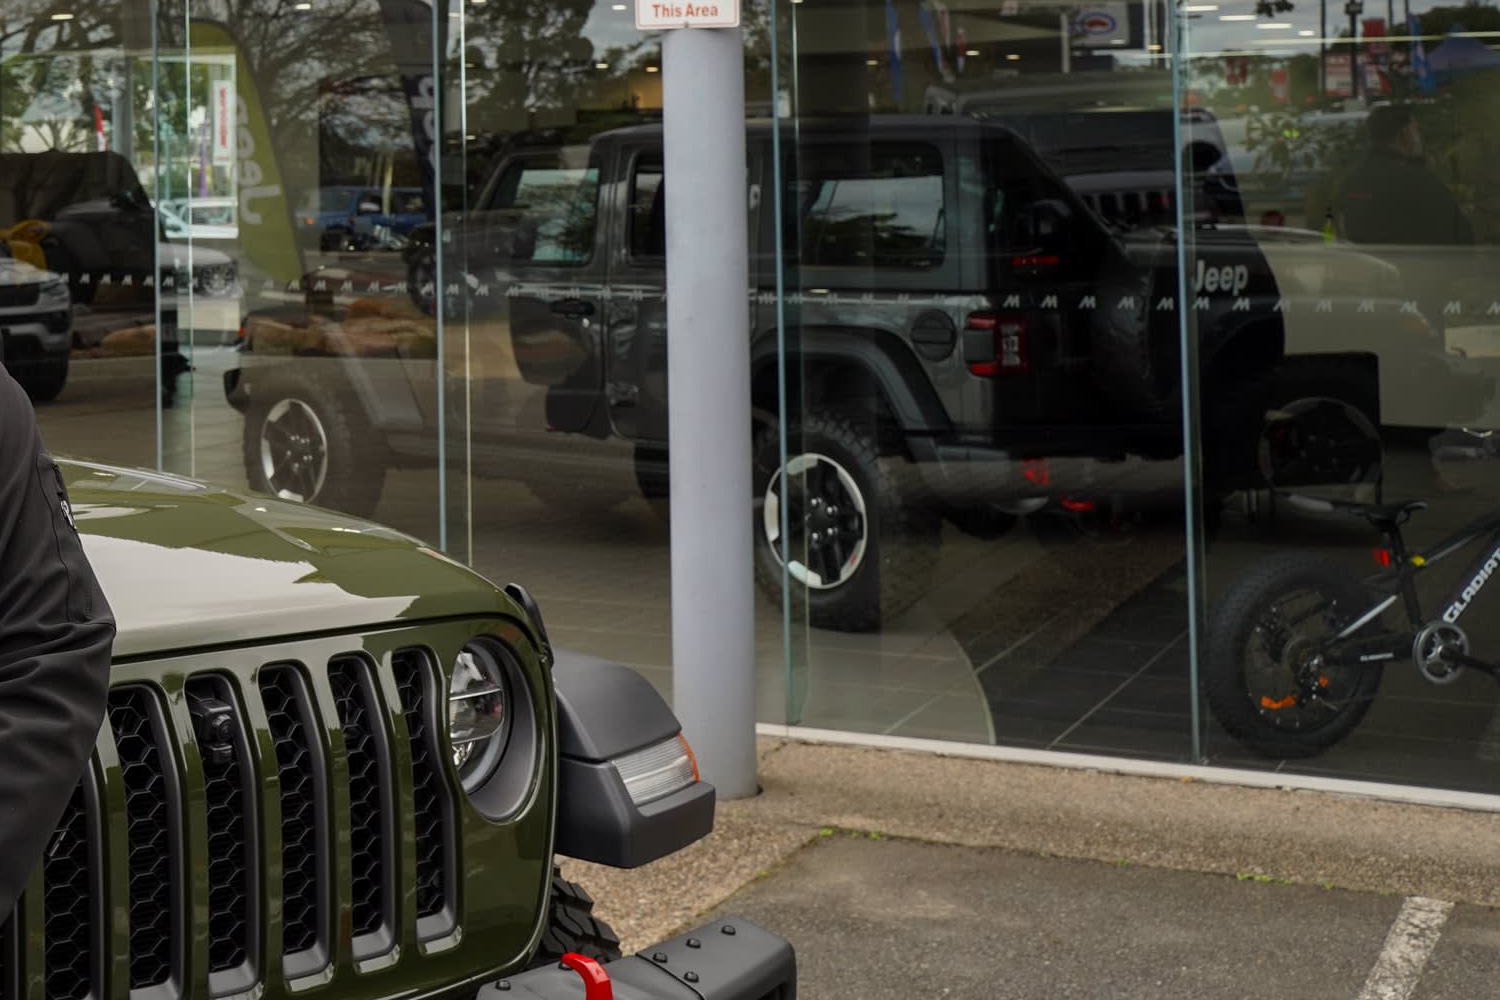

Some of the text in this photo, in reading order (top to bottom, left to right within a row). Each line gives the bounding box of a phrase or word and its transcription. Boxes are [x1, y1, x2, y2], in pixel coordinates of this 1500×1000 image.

[652, 3, 718, 17] This Area
[1192, 259, 1248, 296] Jeep
